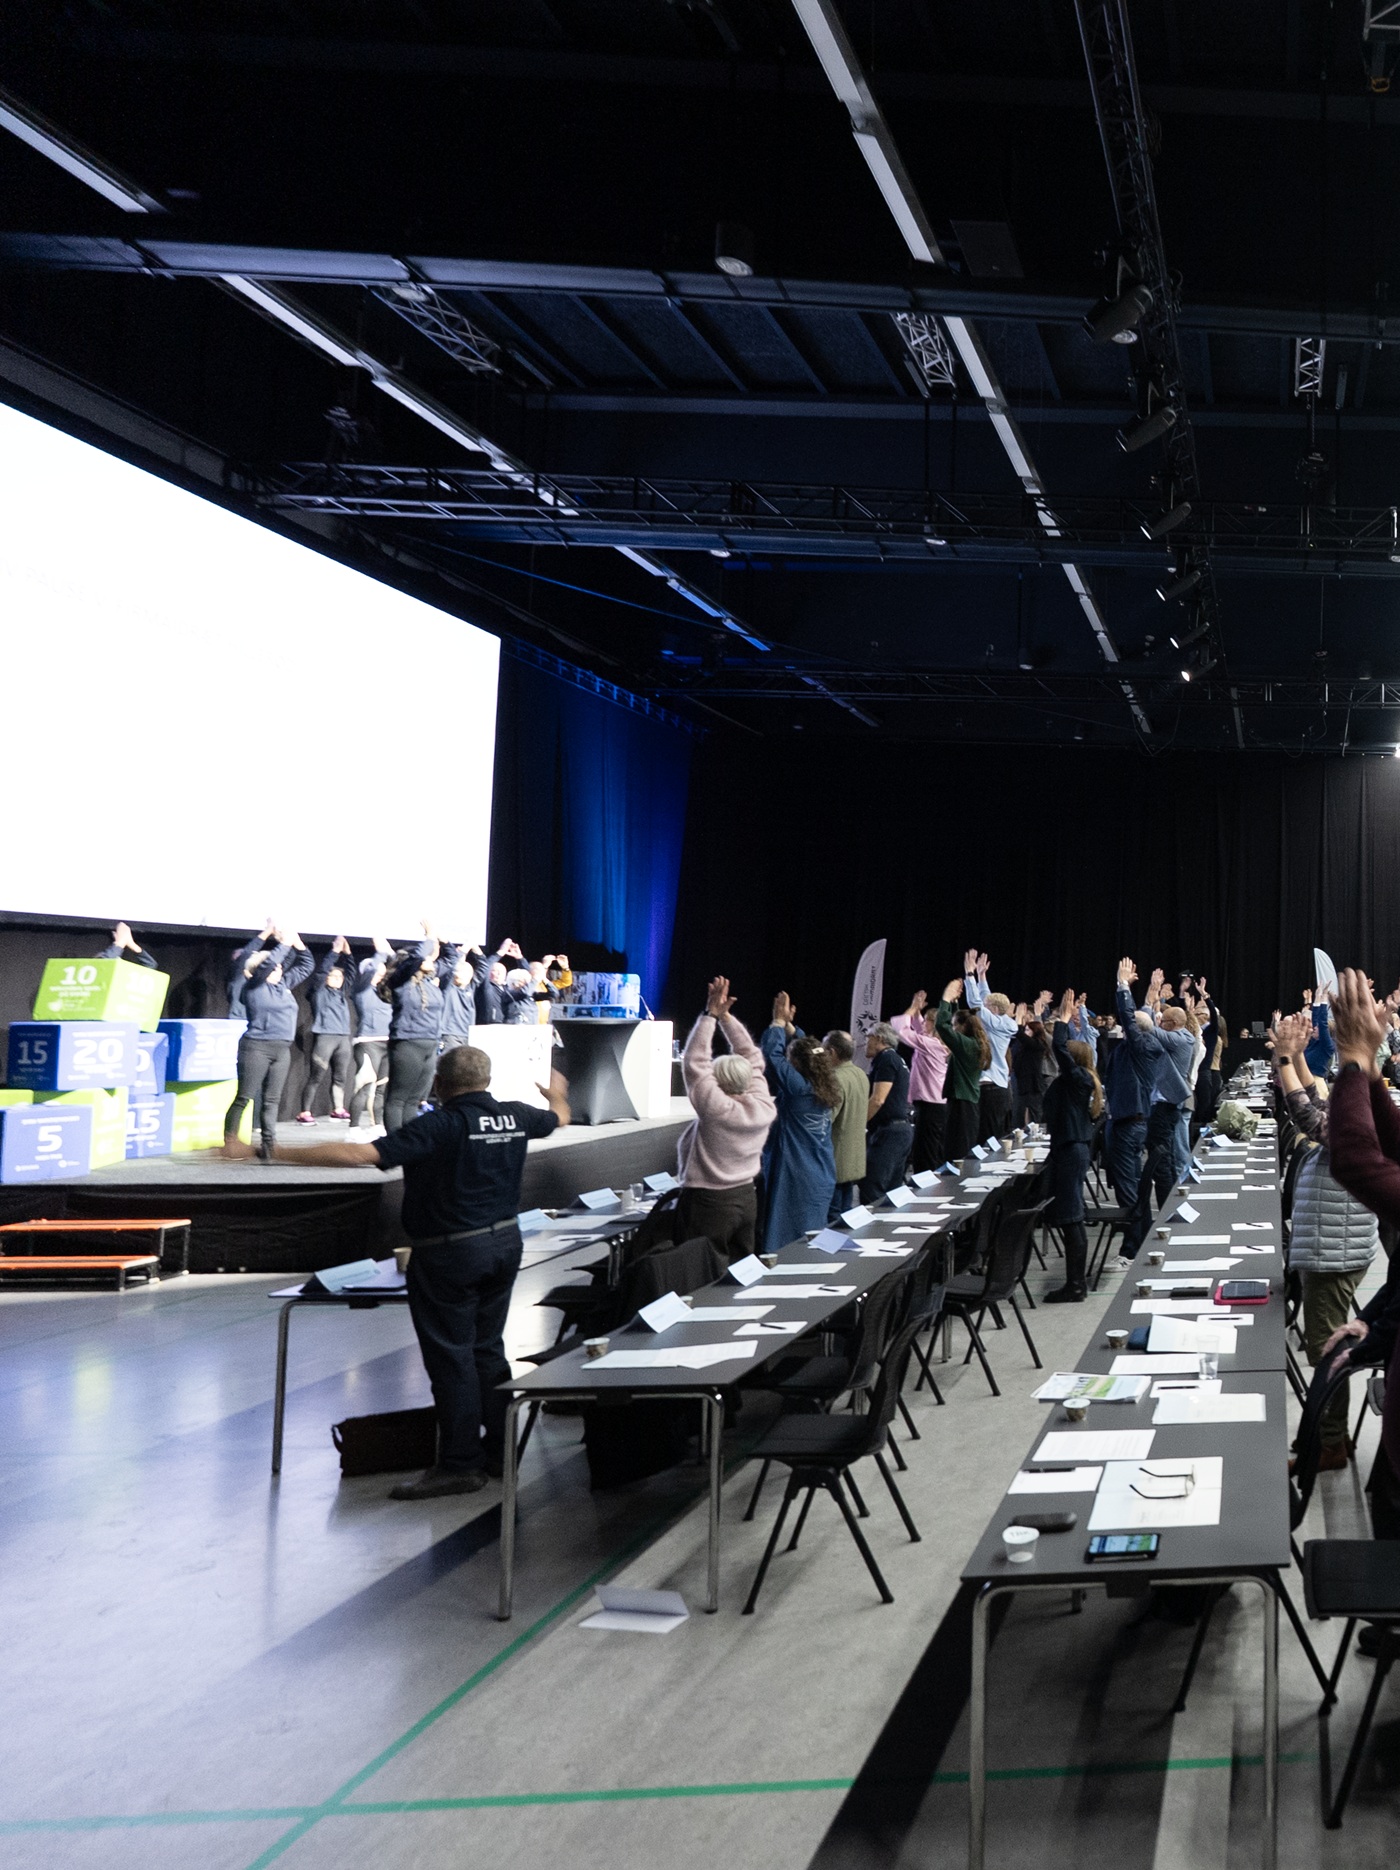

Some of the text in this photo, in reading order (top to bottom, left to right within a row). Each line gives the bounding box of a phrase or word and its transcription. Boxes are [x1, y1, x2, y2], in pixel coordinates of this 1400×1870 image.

[60, 965, 98, 985] 10
[17, 1041, 48, 1064] 15
[73, 1038, 123, 1064] 20
[126, 1109, 160, 1134] 15
[479, 1115, 516, 1131] FUU
[37, 1125, 62, 1152] 5
